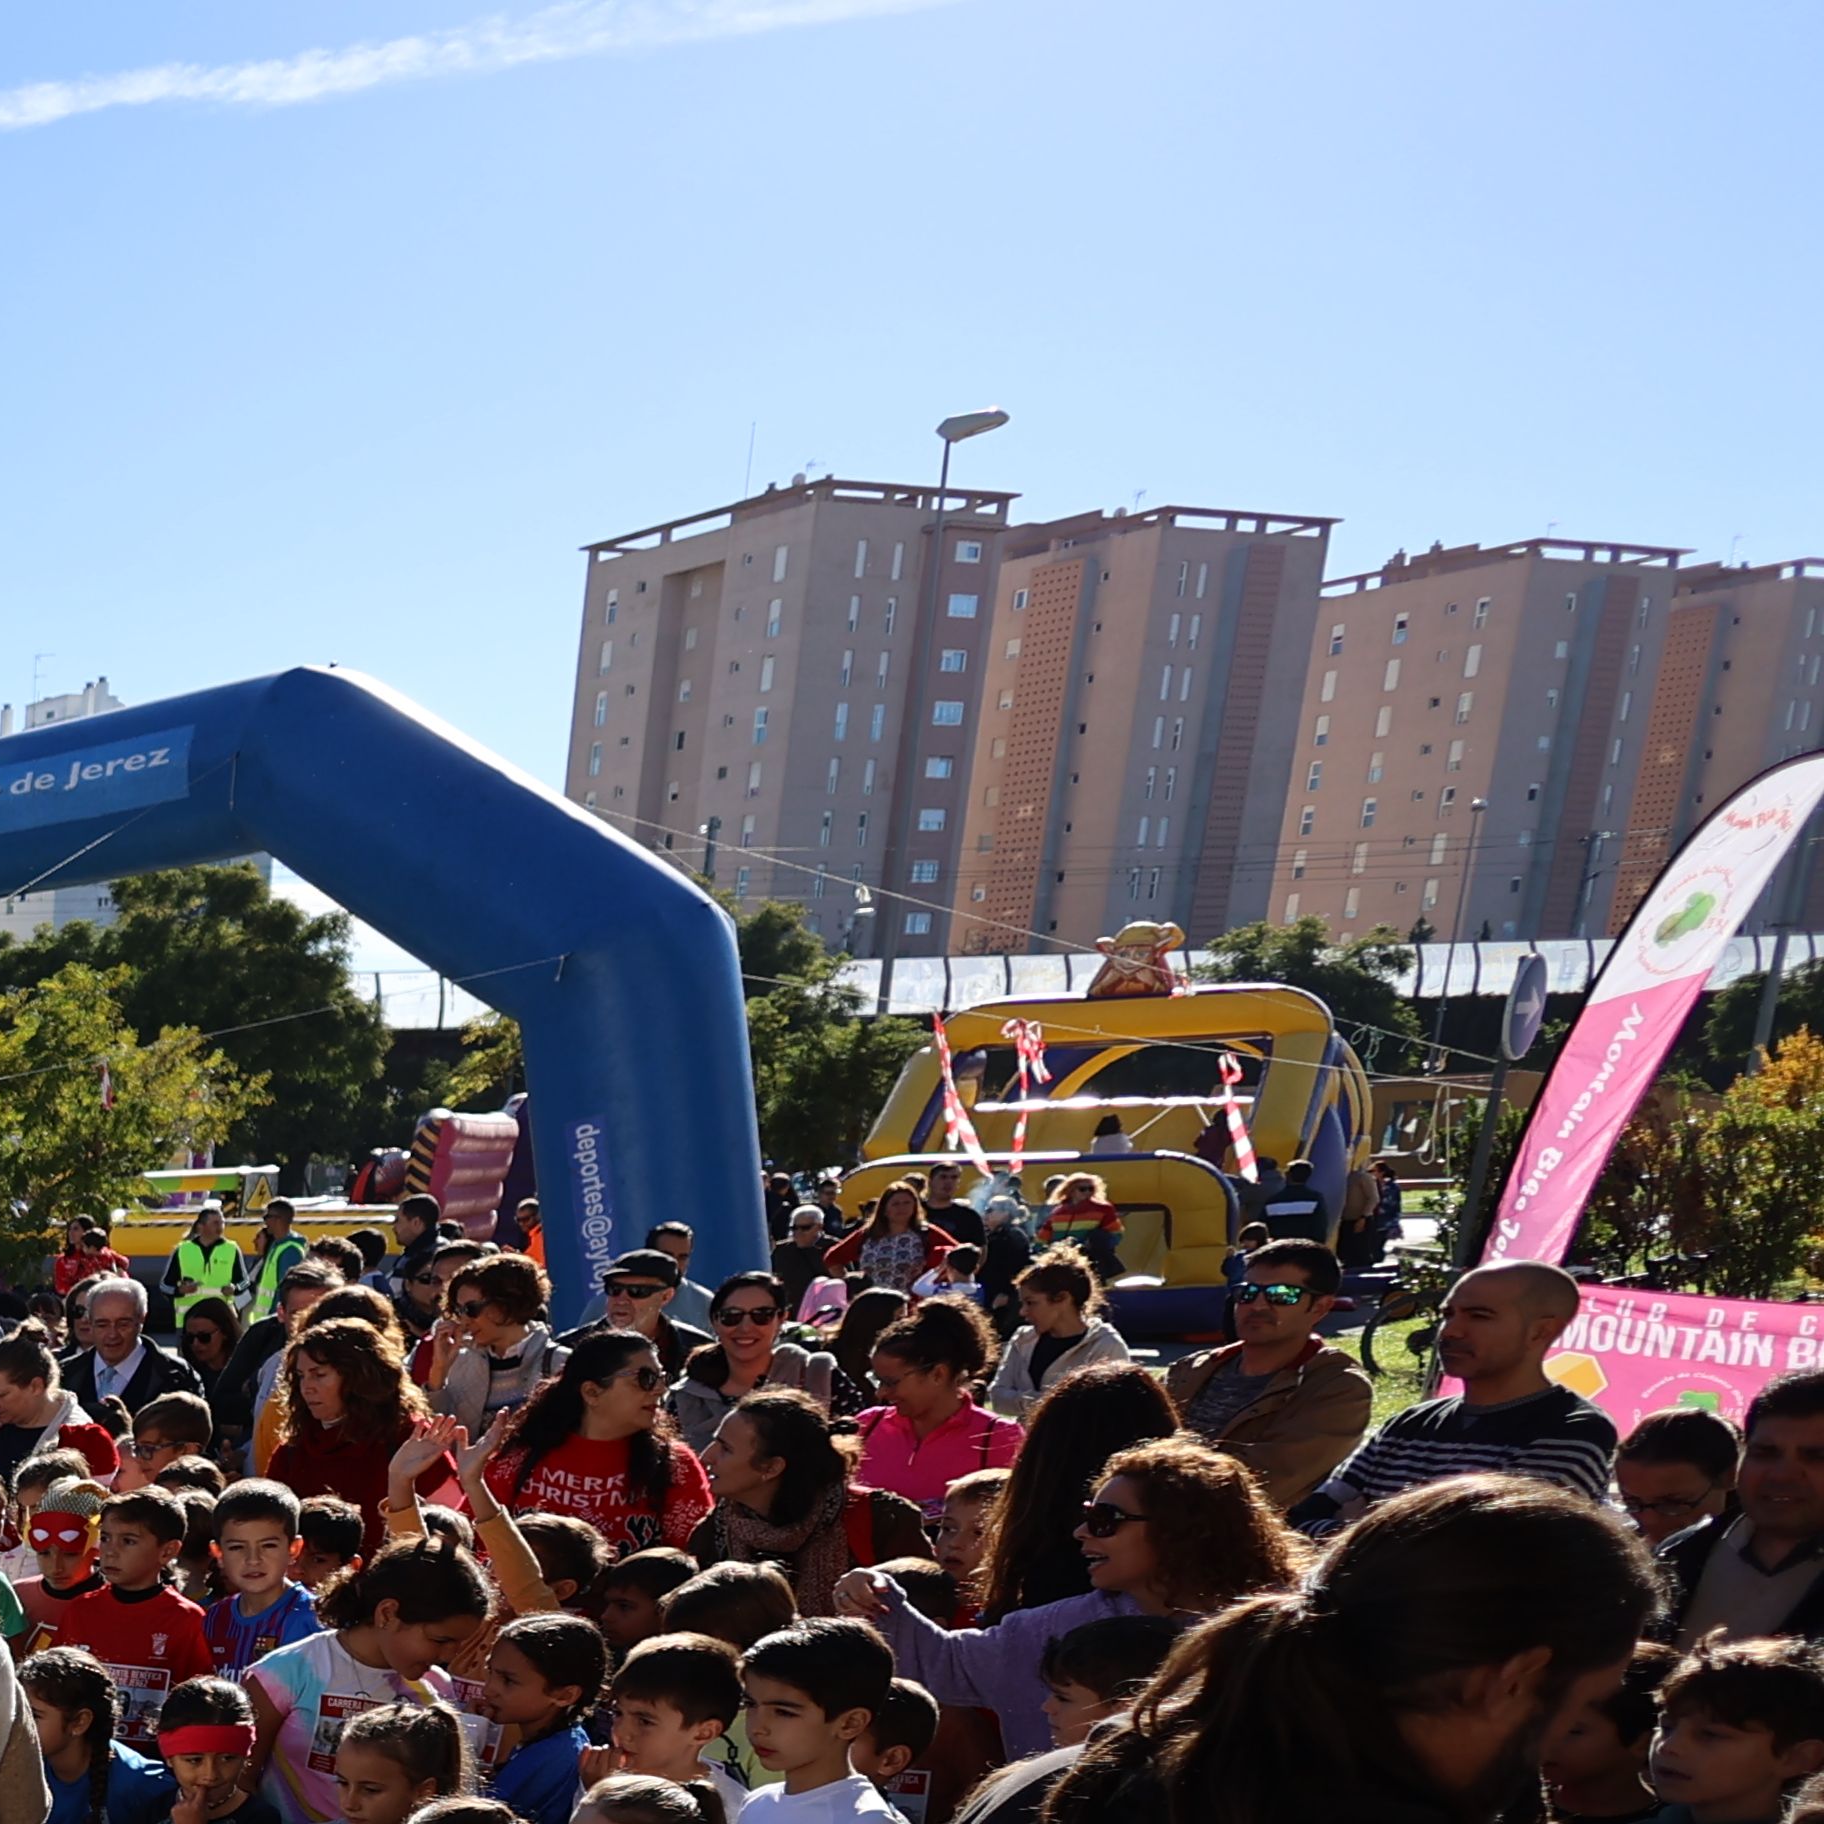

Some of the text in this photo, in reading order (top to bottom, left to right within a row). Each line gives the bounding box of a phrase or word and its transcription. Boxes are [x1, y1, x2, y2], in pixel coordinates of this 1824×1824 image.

[10, 772, 55, 795] de
[64, 747, 170, 790] Jerez
[573, 1123, 614, 1296] deportes@aytoj
[1587, 1296, 1760, 1331] LUB DE
[1551, 1313, 1775, 1368] MOUNTAIN
[521, 1478, 635, 1508] HRISTM
[542, 1466, 626, 1492] MERR
[328, 1697, 363, 1710] CARRERA
